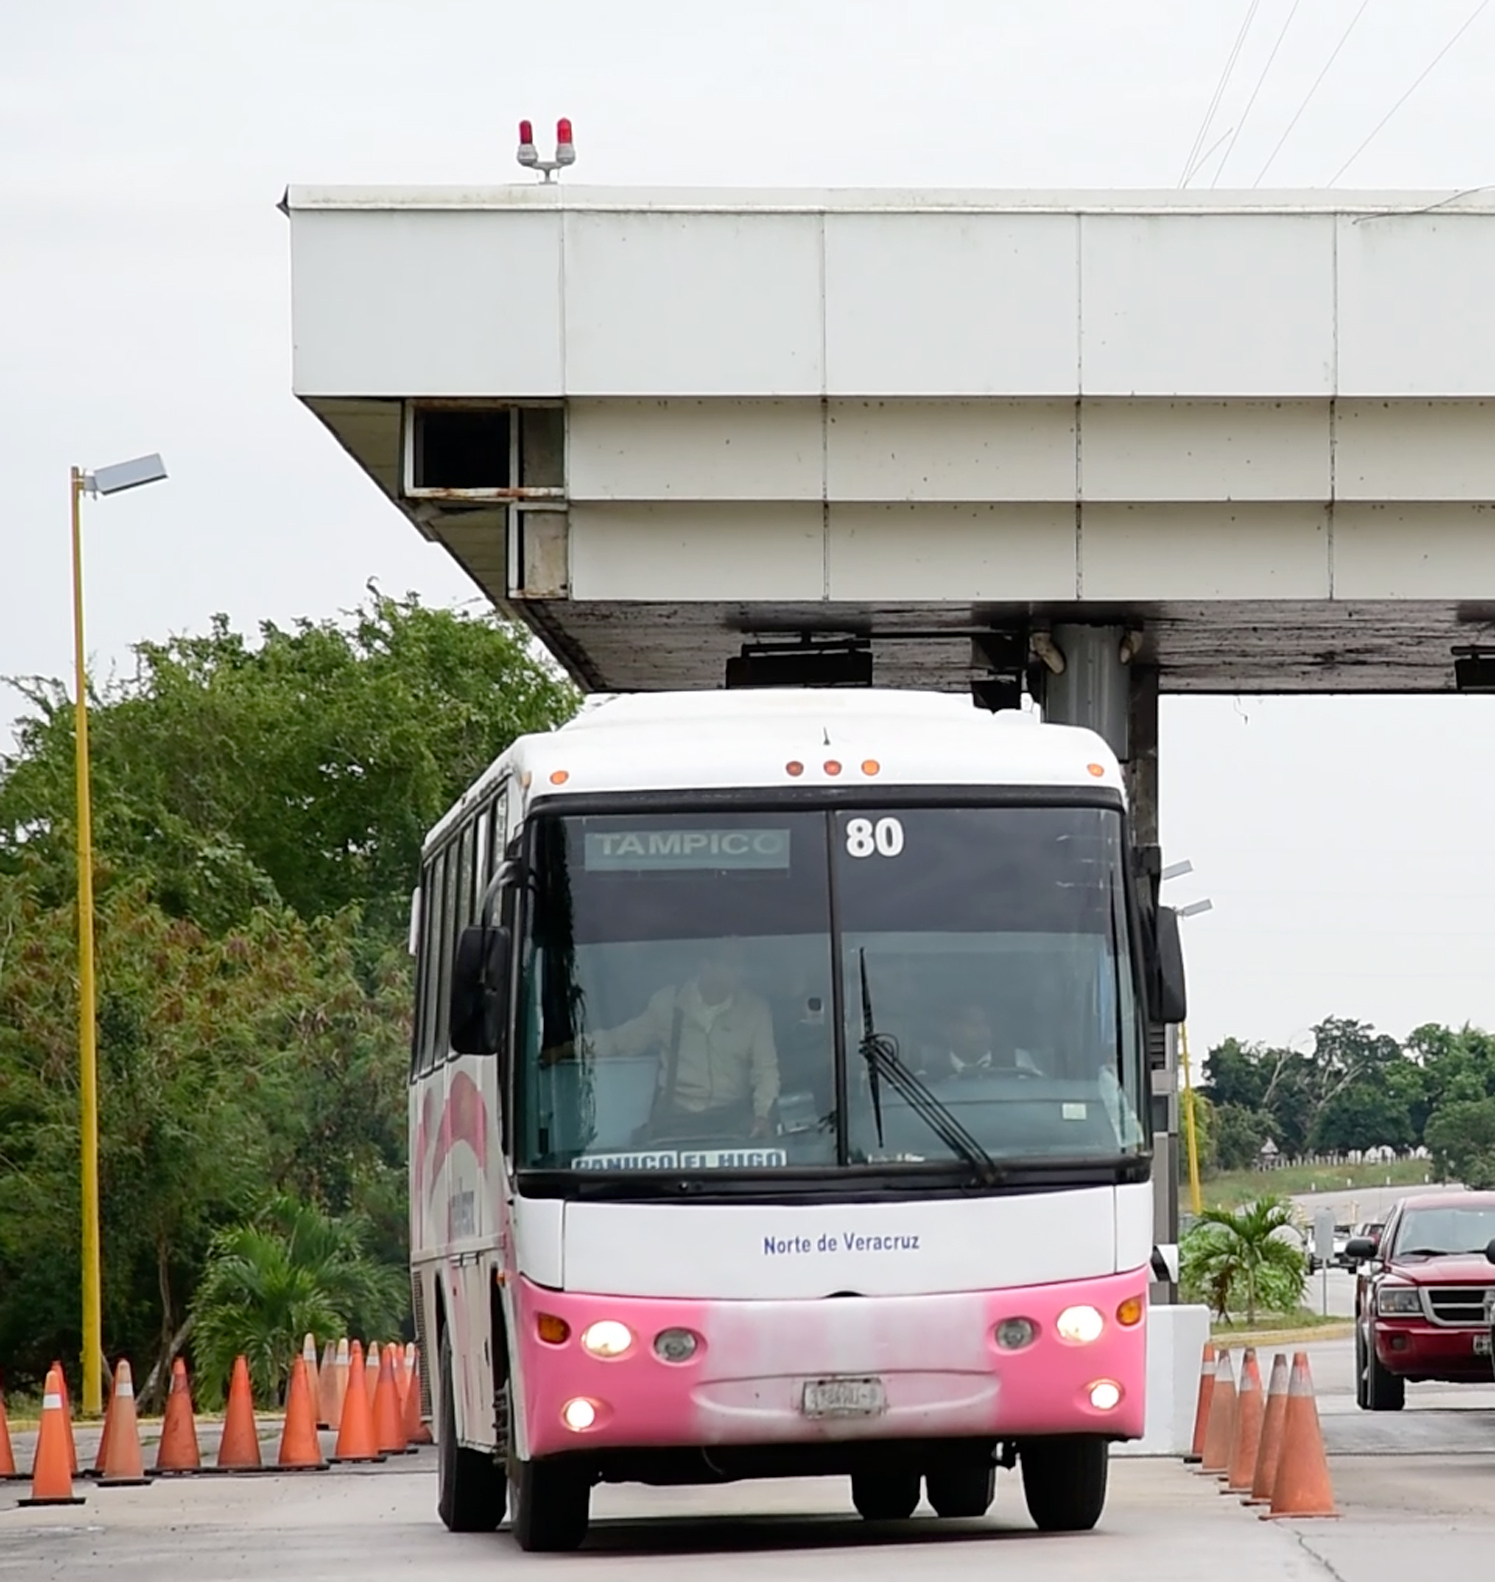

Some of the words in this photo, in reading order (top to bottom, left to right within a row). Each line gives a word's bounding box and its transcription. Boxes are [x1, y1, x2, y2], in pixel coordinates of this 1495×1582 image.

[594, 832, 783, 856] TAMPICO
[846, 816, 904, 857] 80
[763, 1236, 811, 1255] Norte
[817, 1233, 838, 1252] de
[843, 1232, 920, 1251] Veracruz
